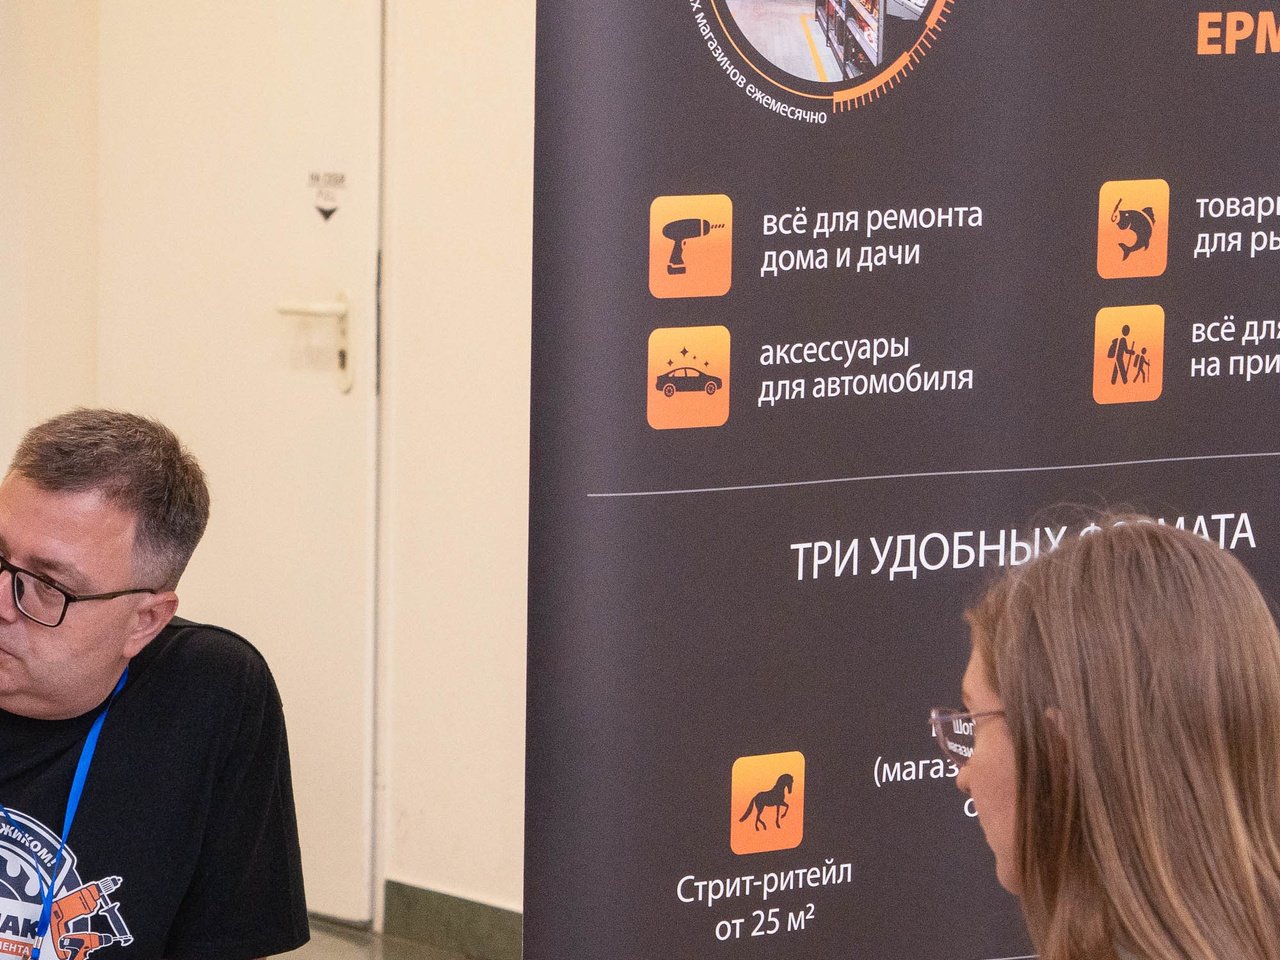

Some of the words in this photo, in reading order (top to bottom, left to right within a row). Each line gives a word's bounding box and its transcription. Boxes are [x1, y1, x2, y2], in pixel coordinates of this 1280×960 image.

[695, 12, 747, 88] магазинов
[745, 83, 827, 124] ежемесячно
[763, 206, 808, 235] всё
[813, 211, 859, 238] для
[866, 206, 983, 238] ремонта
[1196, 196, 1280, 224] товар
[760, 247, 828, 277] дома
[836, 247, 851, 268] и
[857, 244, 920, 272] дачи
[1193, 232, 1242, 258] для
[1192, 315, 1236, 343] всё
[1241, 320, 1280, 346] дл
[759, 337, 909, 368] аксессуары
[1190, 356, 1220, 377] на
[757, 379, 805, 407] для
[812, 363, 973, 398] автомобиля
[790, 539, 859, 581] ТРИ
[870, 525, 1068, 581] УДОБНЫХ
[676, 858, 852, 907] Стрит-ритейл
[715, 918, 745, 941] от
[751, 908, 780, 937] 25
